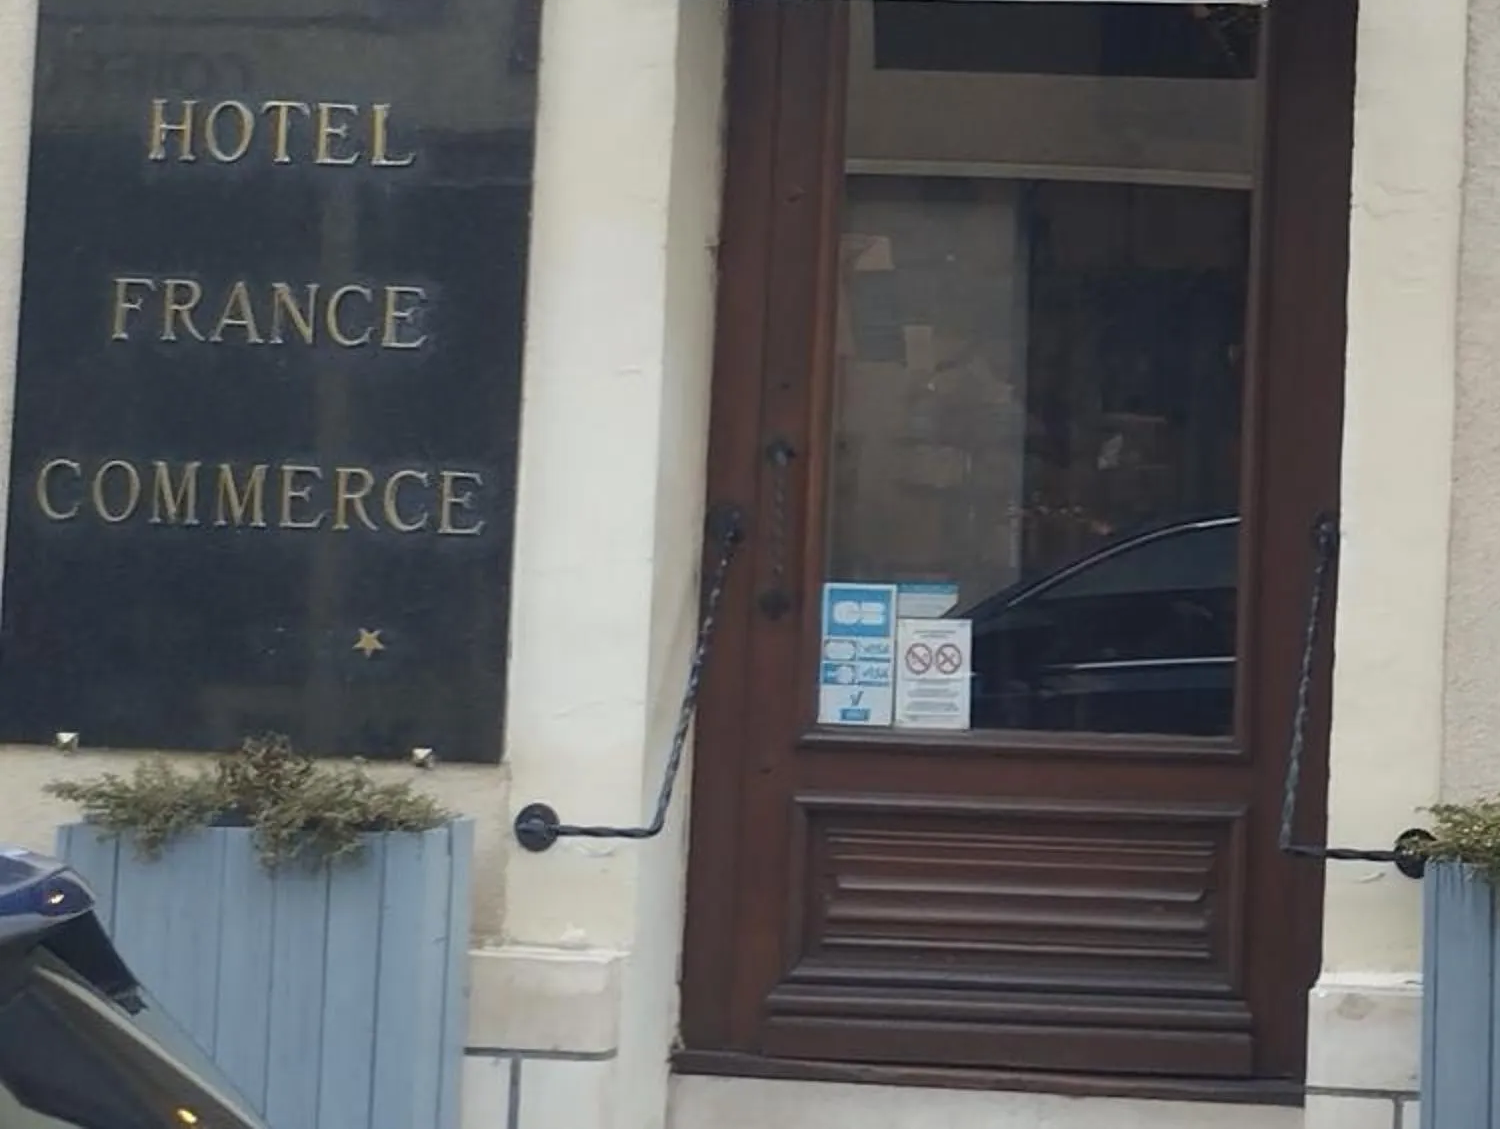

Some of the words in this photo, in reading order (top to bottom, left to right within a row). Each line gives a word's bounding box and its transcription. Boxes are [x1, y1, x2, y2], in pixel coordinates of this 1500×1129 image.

[147, 99, 417, 166] HOTEL
[111, 278, 429, 349] FRANCE
[36, 458, 486, 537] COMMERCE
